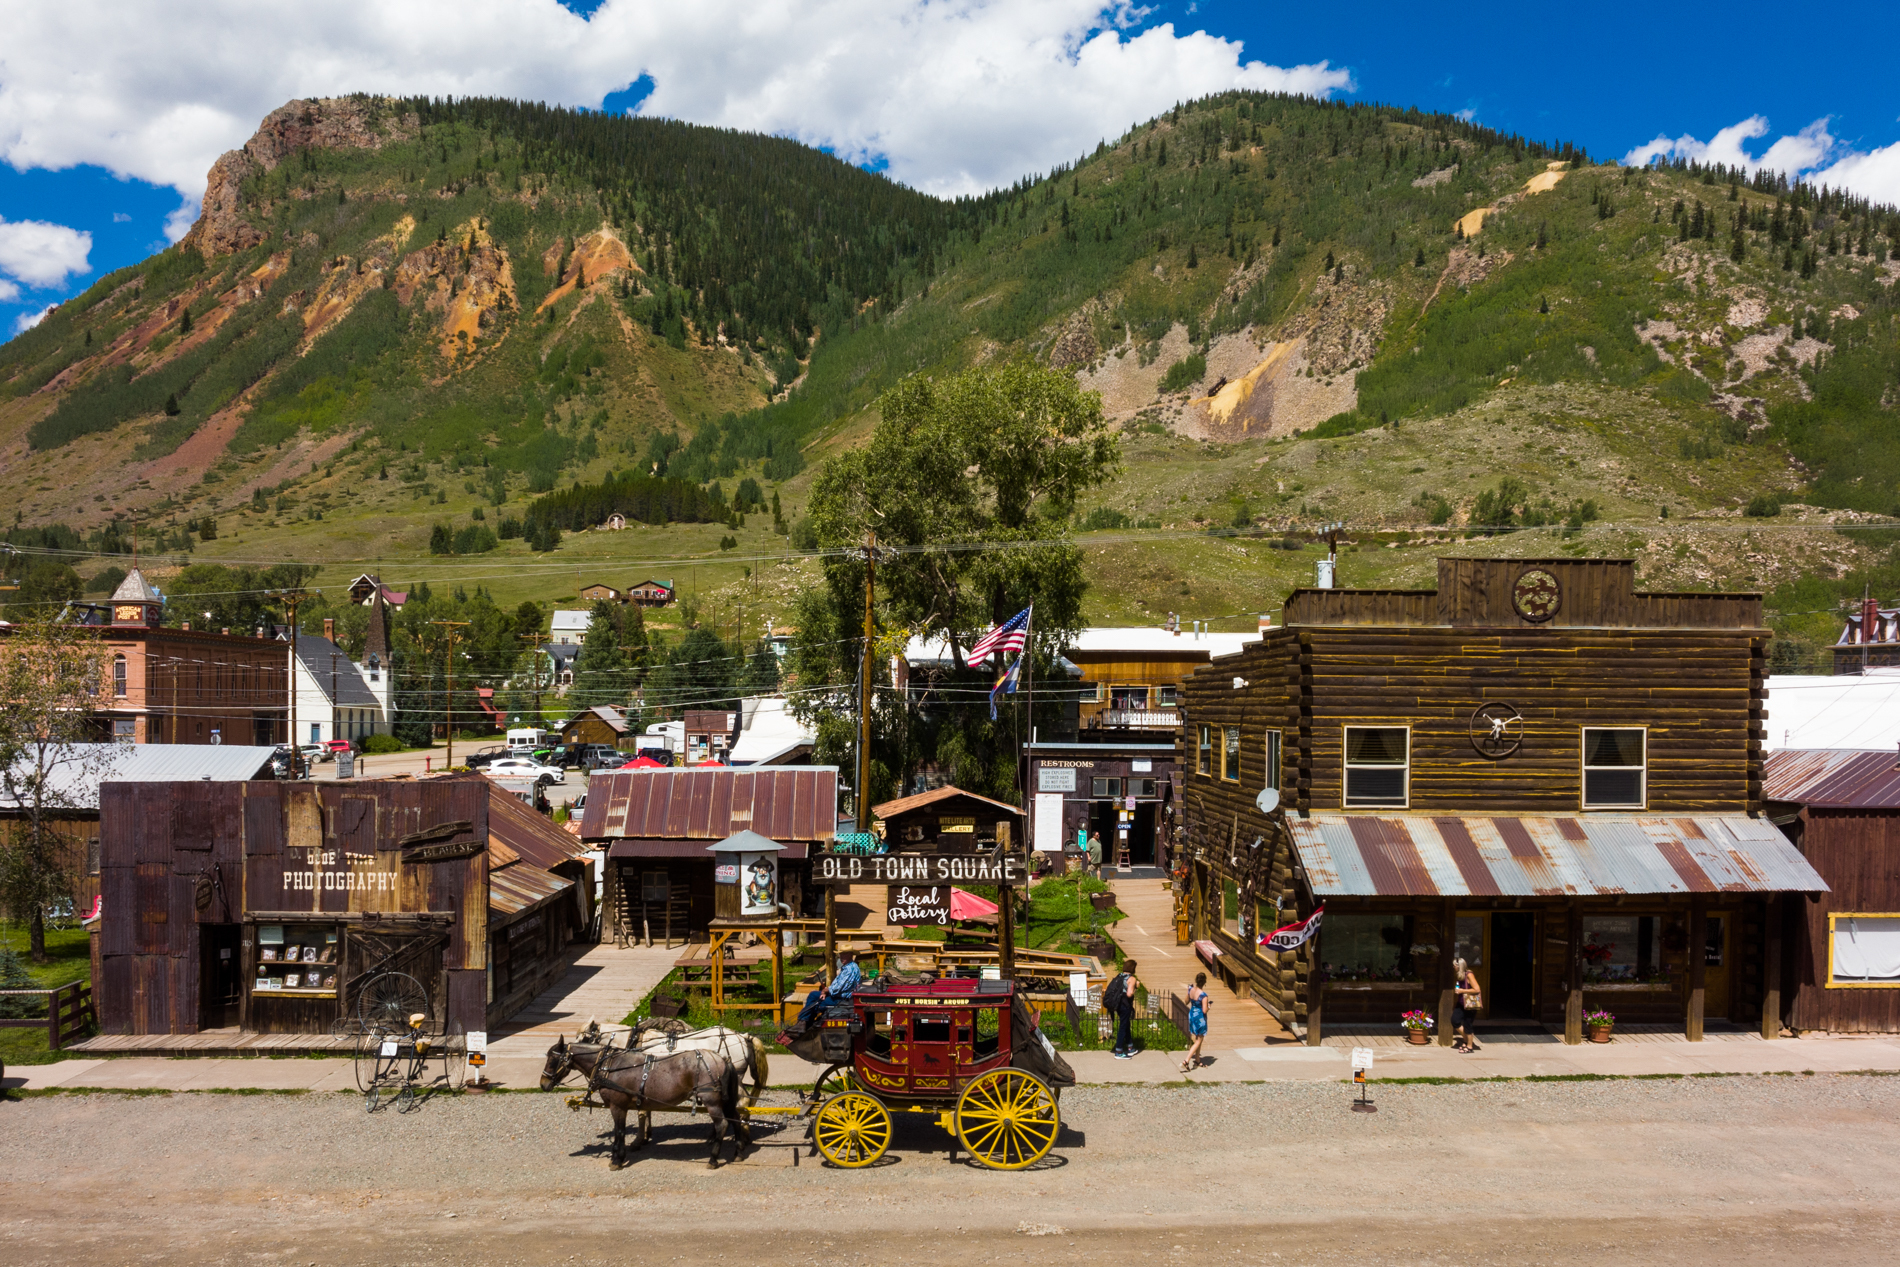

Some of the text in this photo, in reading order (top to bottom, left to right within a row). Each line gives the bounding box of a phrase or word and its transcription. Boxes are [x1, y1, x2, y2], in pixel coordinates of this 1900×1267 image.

[1040, 760, 1095, 768] RESTROOMS
[939, 817, 976, 825] NITE LITE ARTS
[307, 852, 336, 865] OLDE
[345, 852, 376, 866] TYME
[423, 845, 457, 857] BLAIR
[823, 857, 1017, 881] OLD TOWN SQUARE
[283, 871, 398, 891] PHOTOGRAPHY
[896, 886, 941, 905] Local
[888, 904, 949, 925] Pottery
